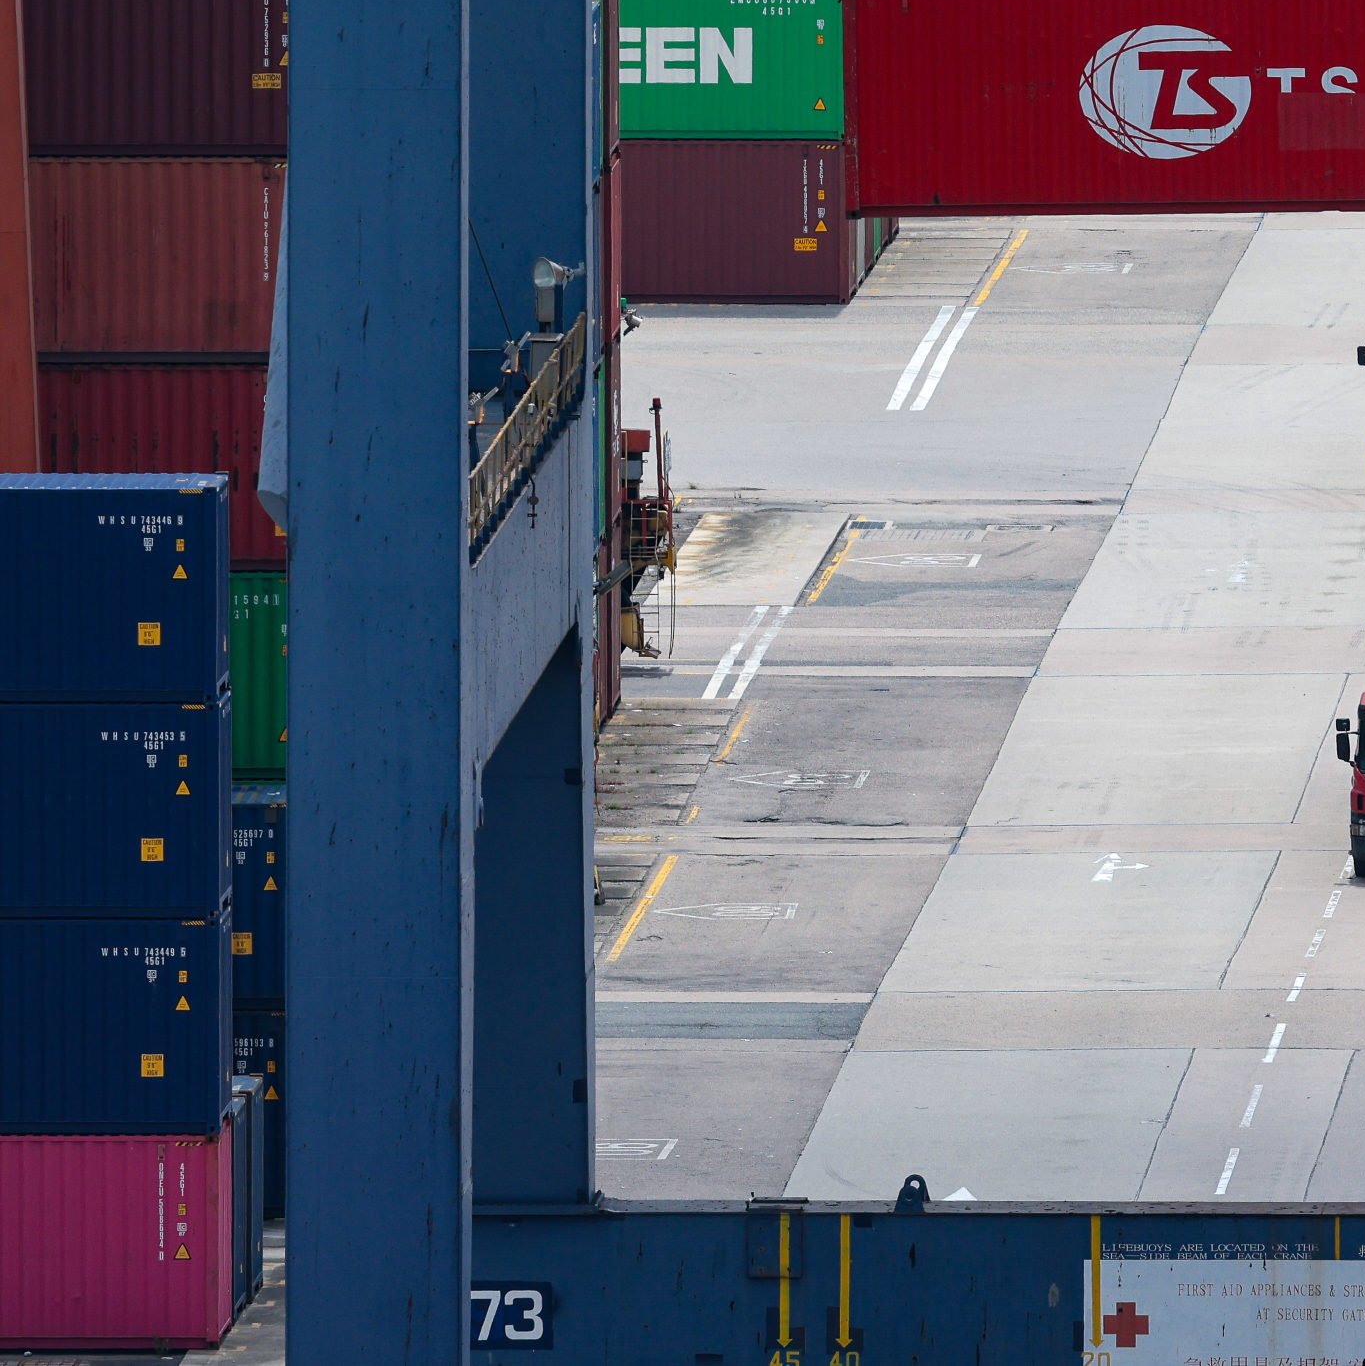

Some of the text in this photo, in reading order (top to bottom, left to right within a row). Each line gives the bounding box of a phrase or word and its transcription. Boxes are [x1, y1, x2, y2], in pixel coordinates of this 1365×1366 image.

[762, 7, 791, 16] 45G1
[252, 74, 281, 82] CAUTION
[98, 515, 172, 526] WHSU 743446
[141, 525, 162, 535] 45G1
[101, 731, 175, 742] WHSU 743453
[143, 741, 165, 751] 45G1
[233, 838, 254, 848] 45G1
[101, 947, 176, 958] WHSU 743449
[144, 956, 166, 966] 45G1
[1102, 1242, 1287, 1253] LIFEBUOYS ARE LOCATED ON
[1177, 1252, 1313, 1260] BEAM OF CRANE
[1178, 1283, 1215, 1298] FIRST
[1221, 1284, 1244, 1298] AID
[1250, 1283, 1323, 1298] APPLIANCES
[1329, 1284, 1337, 1297] &
[469, 1289, 544, 1342] 73
[1256, 1307, 1270, 1322] AT
[1276, 1308, 1336, 1322] SECURITY
